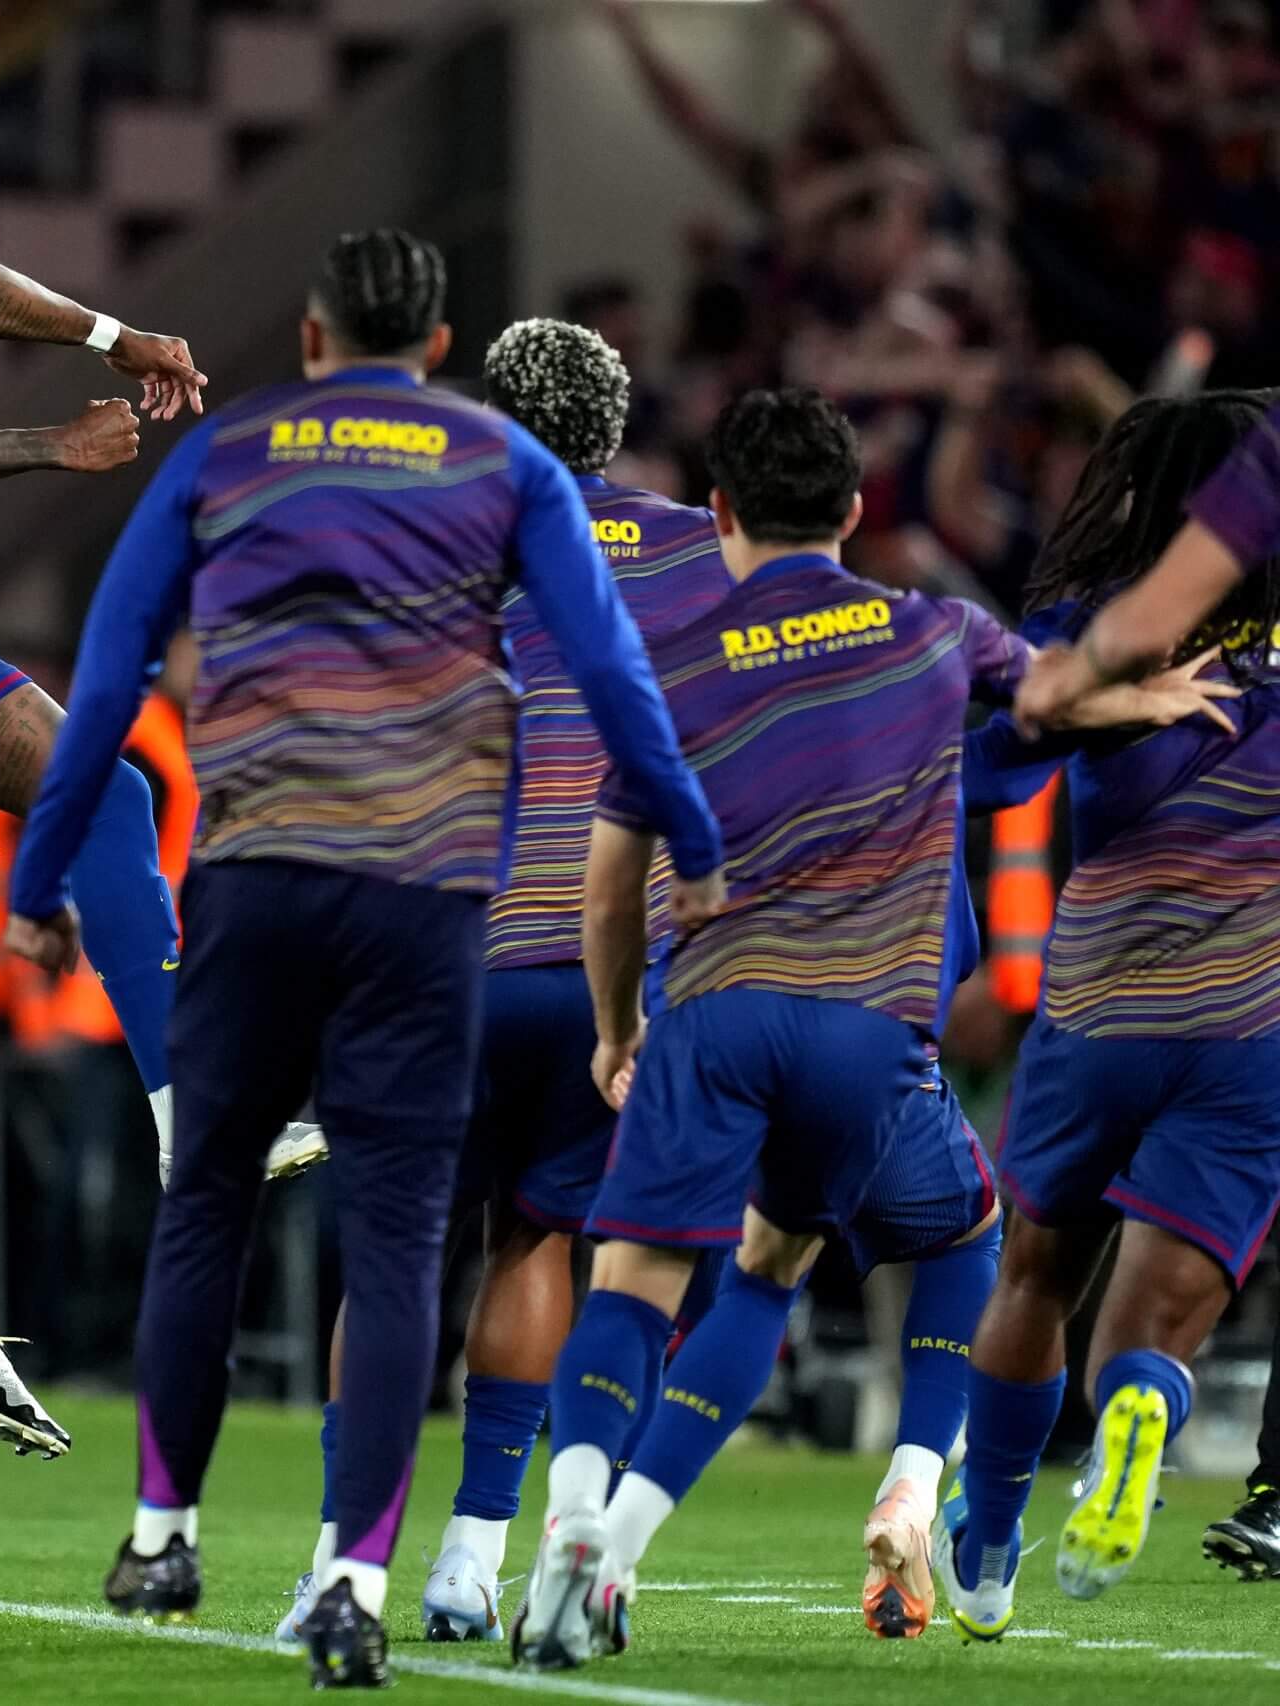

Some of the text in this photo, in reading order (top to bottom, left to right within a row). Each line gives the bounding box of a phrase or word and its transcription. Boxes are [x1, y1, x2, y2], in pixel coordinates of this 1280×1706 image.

[329, 417, 449, 457] CONGO
[721, 598, 892, 659] R.D. CONGO
